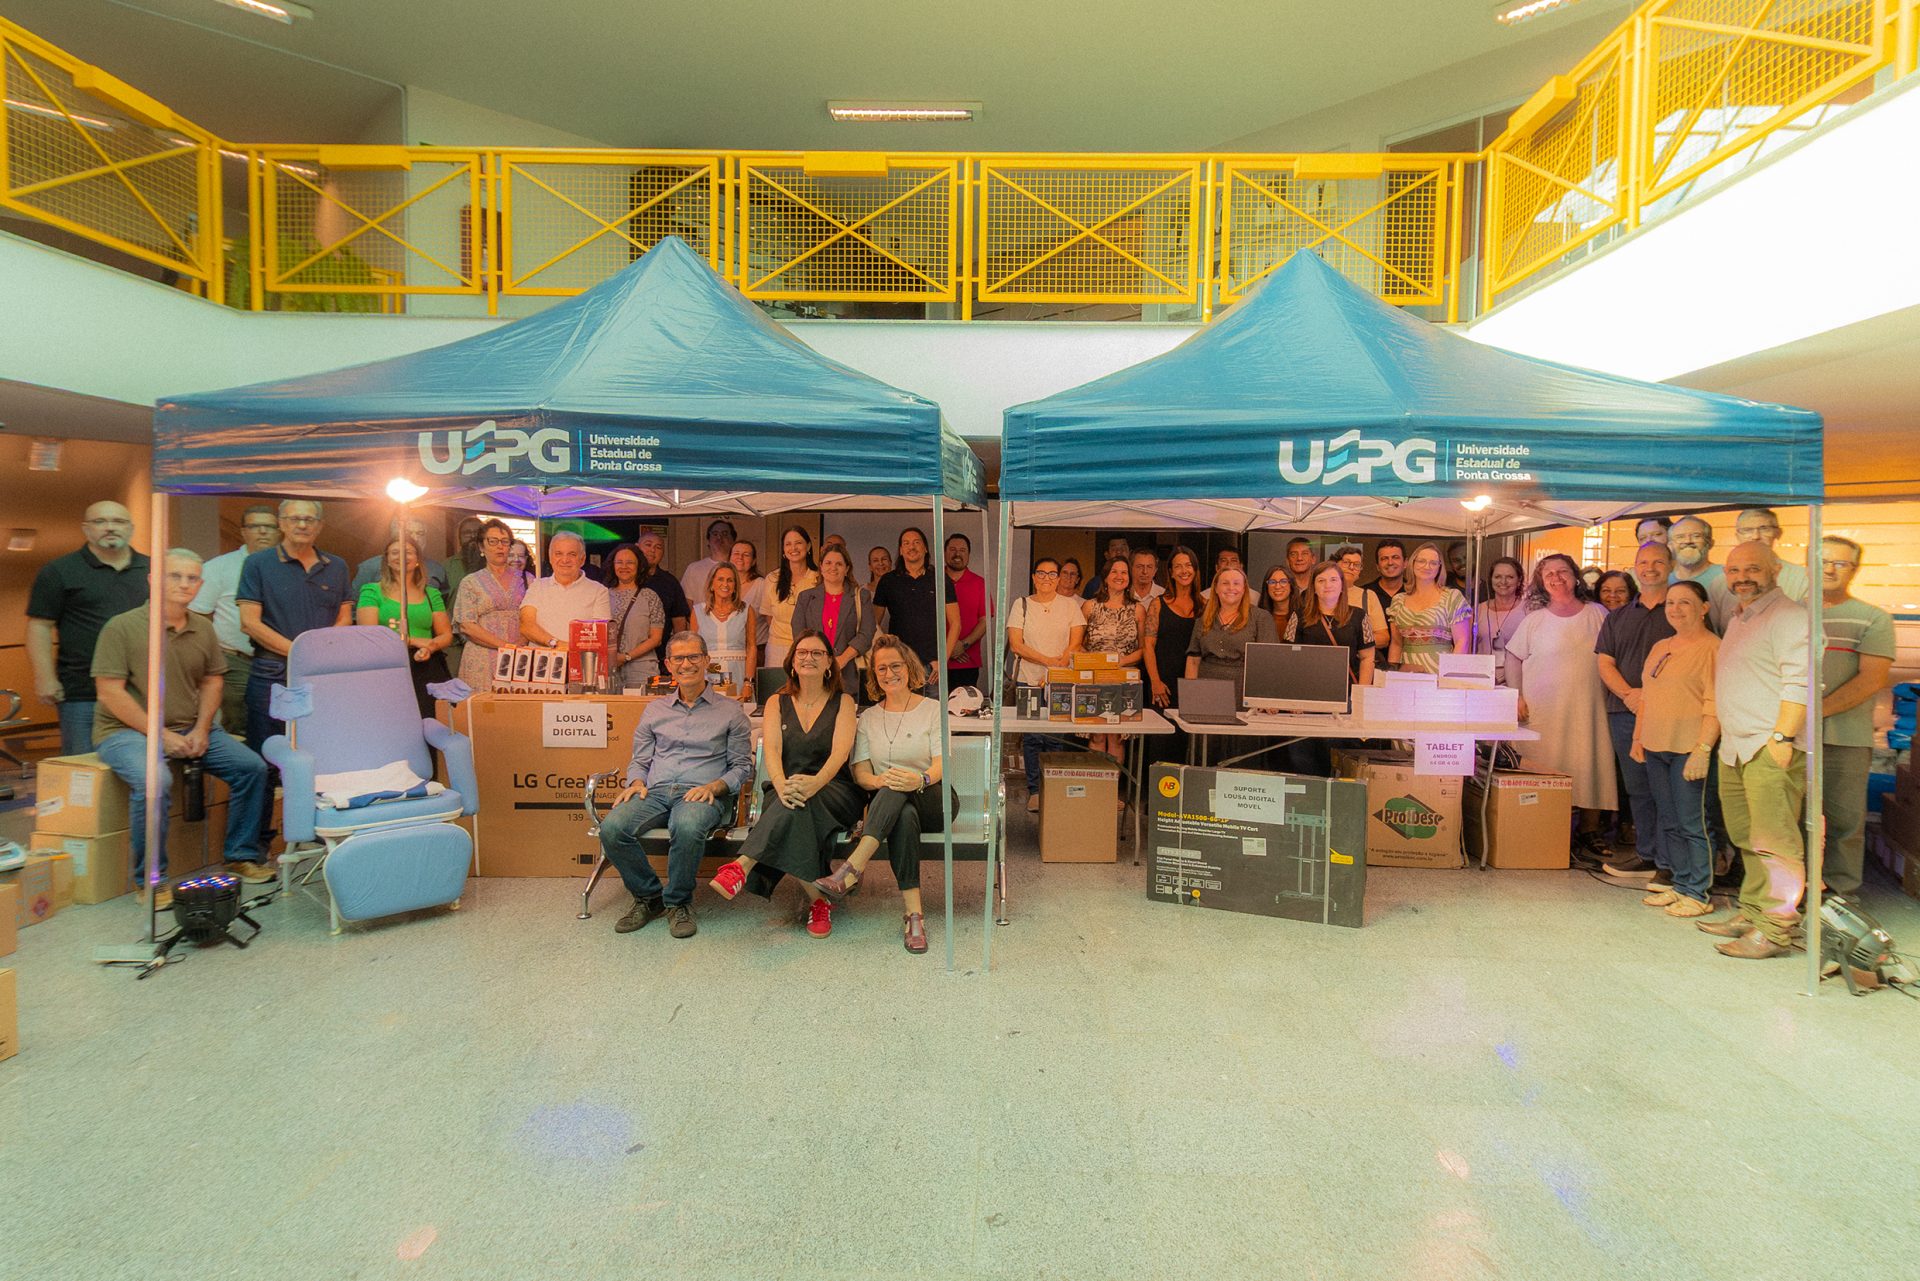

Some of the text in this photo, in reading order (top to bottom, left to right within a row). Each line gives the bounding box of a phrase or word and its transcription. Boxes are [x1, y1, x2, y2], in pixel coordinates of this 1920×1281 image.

[589, 433, 660, 446] Universidade
[418, 420, 570, 475] UEPG
[590, 447, 652, 459] Estadual de
[1456, 443, 1530, 456] Universidade
[1278, 429, 1436, 485] UEPG
[1455, 457, 1521, 469] Estadual de
[590, 460, 662, 472] Ponta Grossa
[1456, 469, 1532, 481] Ponta Grossa
[556, 714, 594, 723] LOUSA
[552, 728, 597, 737] DIGITAL
[1425, 743, 1465, 751] TABLET
[513, 773, 539, 789] LG
[1233, 785, 1267, 794] SUPORTE
[1248, 795, 1277, 803] DIGITAL
[1237, 802, 1262, 810] MOVEL
[567, 813, 584, 822] 139
[1174, 818, 1201, 827] Adustable
